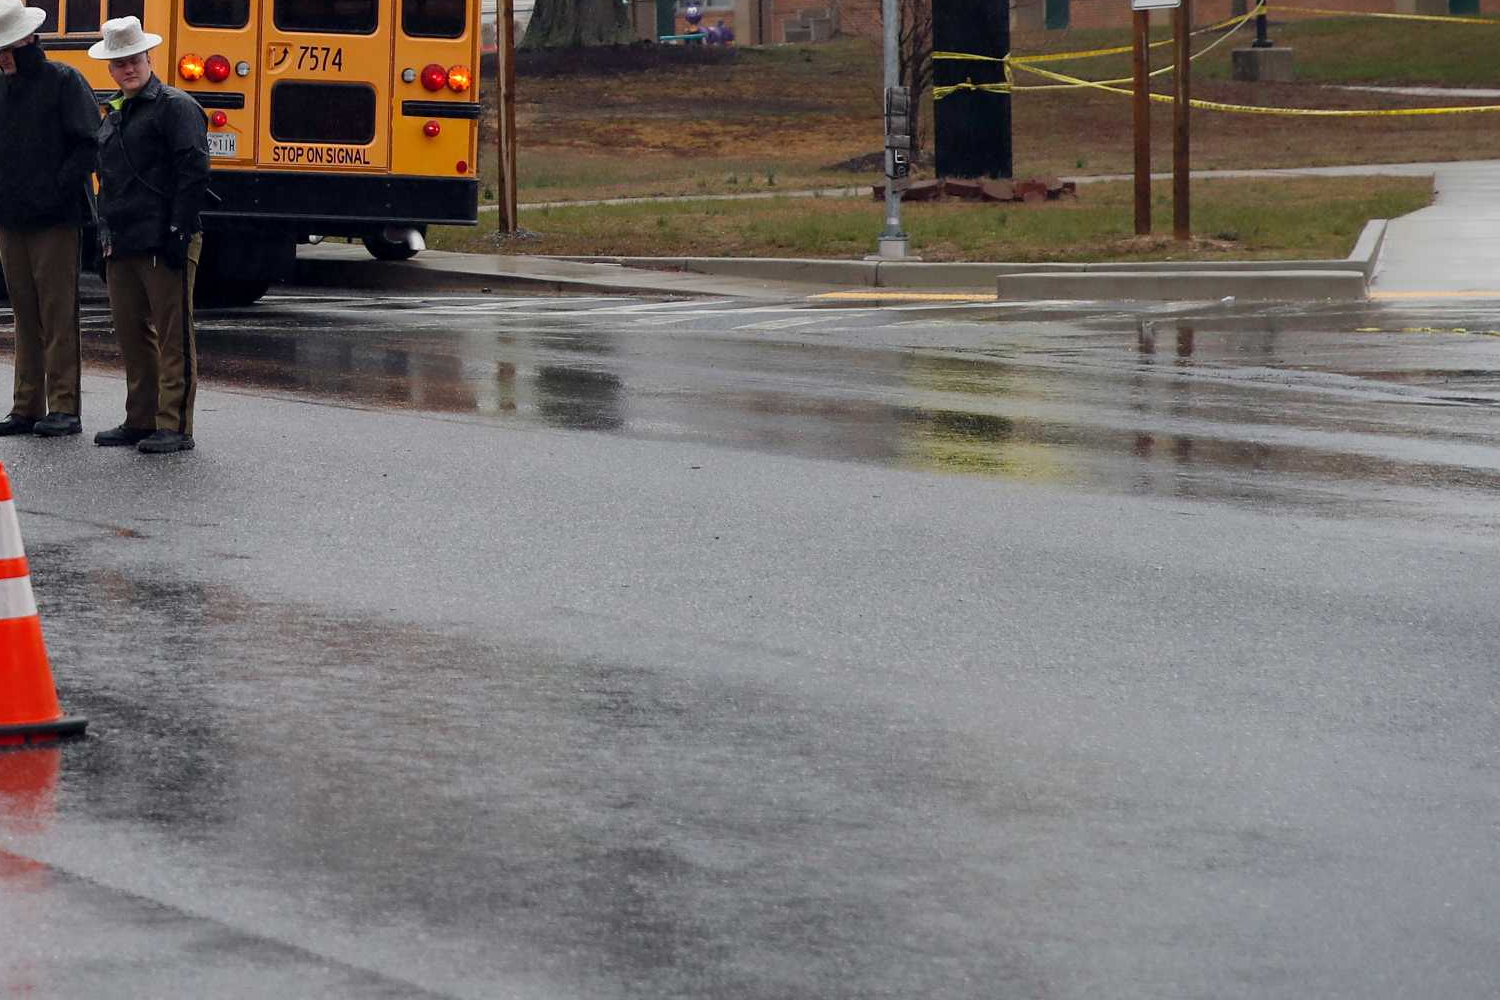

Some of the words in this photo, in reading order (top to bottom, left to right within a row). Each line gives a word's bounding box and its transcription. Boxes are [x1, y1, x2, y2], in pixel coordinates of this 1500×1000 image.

[297, 46, 343, 71] 7574
[272, 146, 303, 162] STOP
[307, 147, 324, 163] ON
[326, 148, 370, 165] SIGNAL
